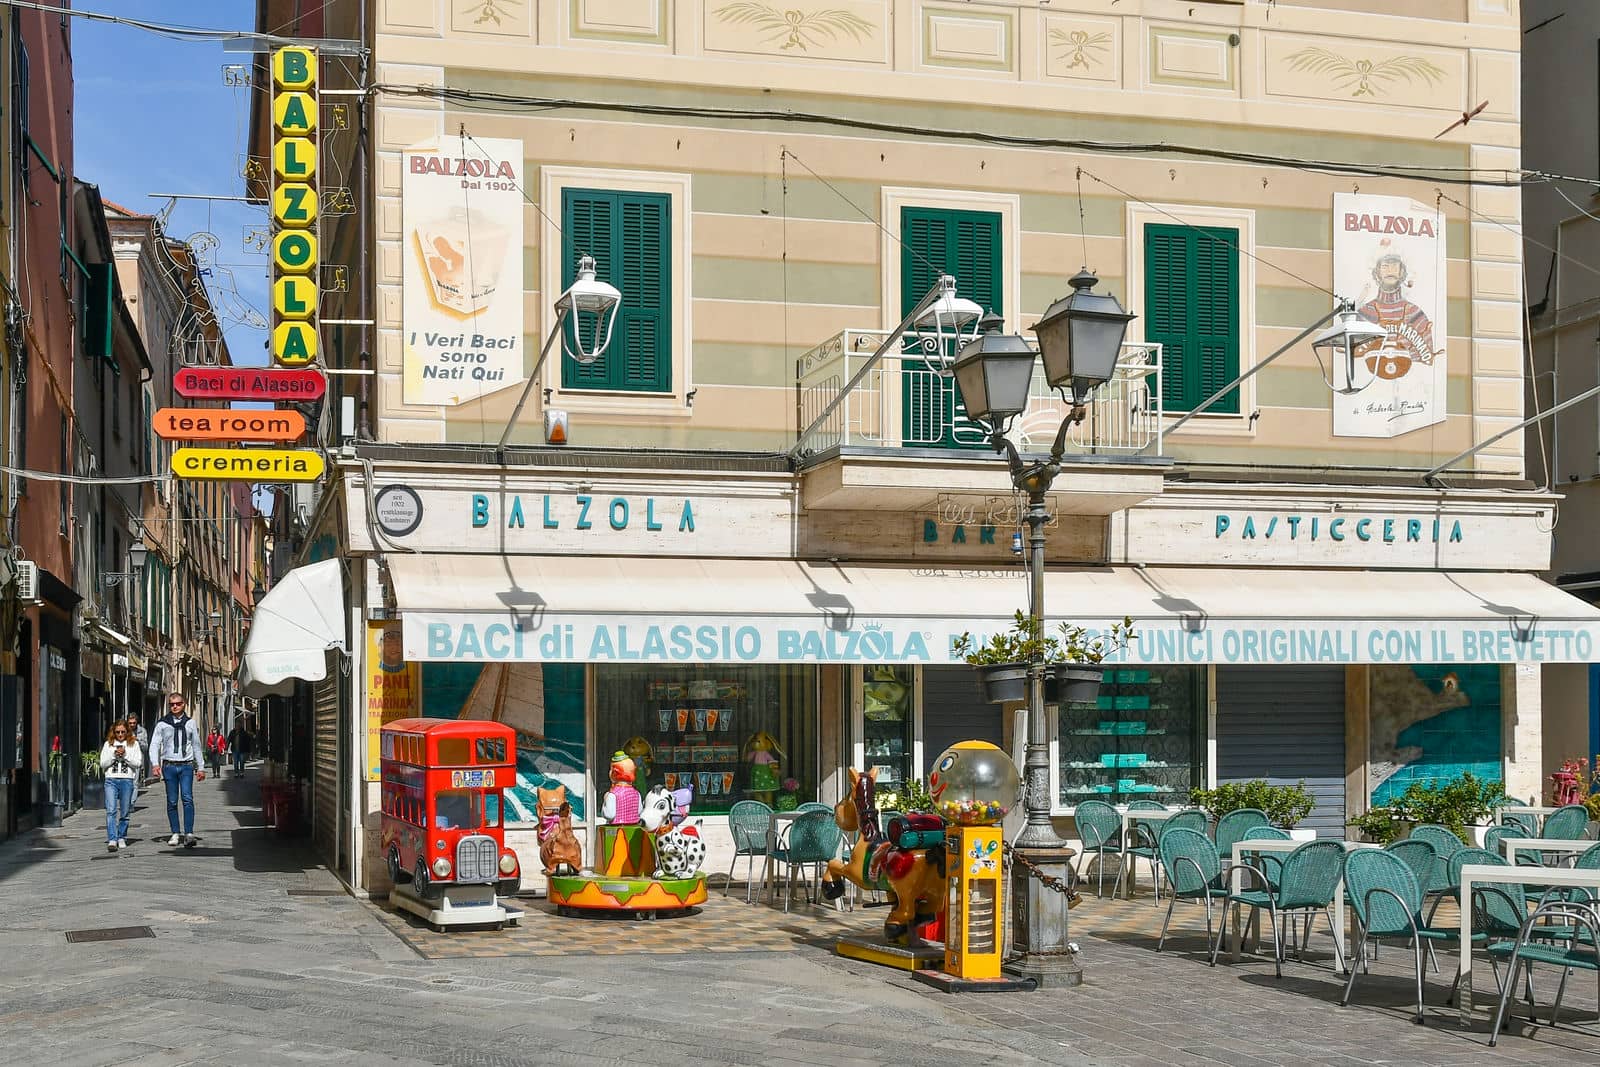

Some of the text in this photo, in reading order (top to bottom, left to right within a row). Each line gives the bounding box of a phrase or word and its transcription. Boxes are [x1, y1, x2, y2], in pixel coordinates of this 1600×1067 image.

[410, 156, 515, 179] BALZOLA
[461, 180, 516, 191] Dal 1902
[282, 51, 309, 359] BALZOLA
[1345, 213, 1435, 238] BALZOLA
[410, 332, 515, 349] I Veri Baci
[1398, 322, 1432, 361] MARINAIO
[440, 352, 487, 363] sono
[186, 375, 316, 393] Baci di Alassio
[423, 365, 504, 381] Nati Qui
[169, 416, 290, 432] tea room
[185, 456, 307, 472] cremeria
[472, 494, 695, 532] BALZOLA
[924, 518, 996, 545] BAR
[1216, 515, 1462, 543] PASTICCERIA
[427, 623, 524, 659] BACI
[540, 623, 574, 659] di
[589, 625, 762, 661] ALASSIO
[778, 630, 931, 660] BALZOLA
[1138, 629, 1213, 662] UNICI
[1222, 630, 1358, 662] ORIGINALI
[1367, 630, 1421, 662] CON
[1431, 630, 1455, 662] IL
[1463, 630, 1592, 662] BREVETTO
